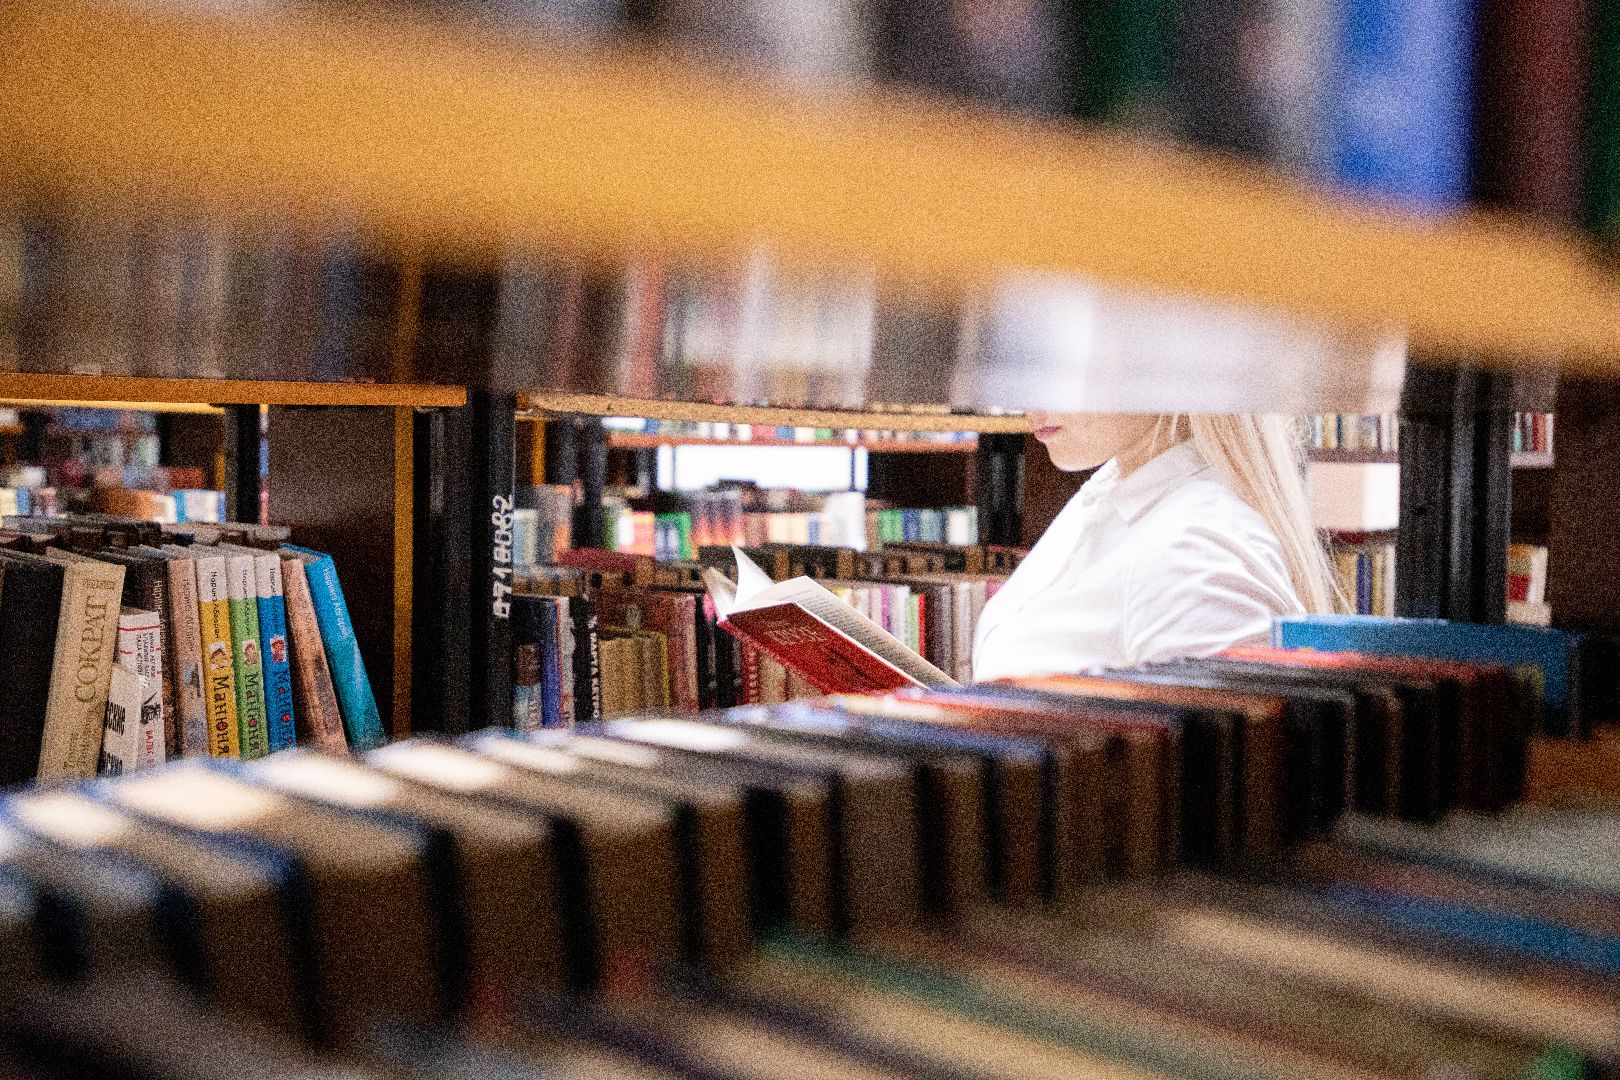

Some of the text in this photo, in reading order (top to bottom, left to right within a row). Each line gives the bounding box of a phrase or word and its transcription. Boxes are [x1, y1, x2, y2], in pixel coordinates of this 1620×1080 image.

[75, 594, 109, 705] СОКРАТ
[589, 632, 600, 719] МАРТА КЕТРО
[212, 675, 231, 757] Манюня
[244, 673, 261, 755] Манюня
